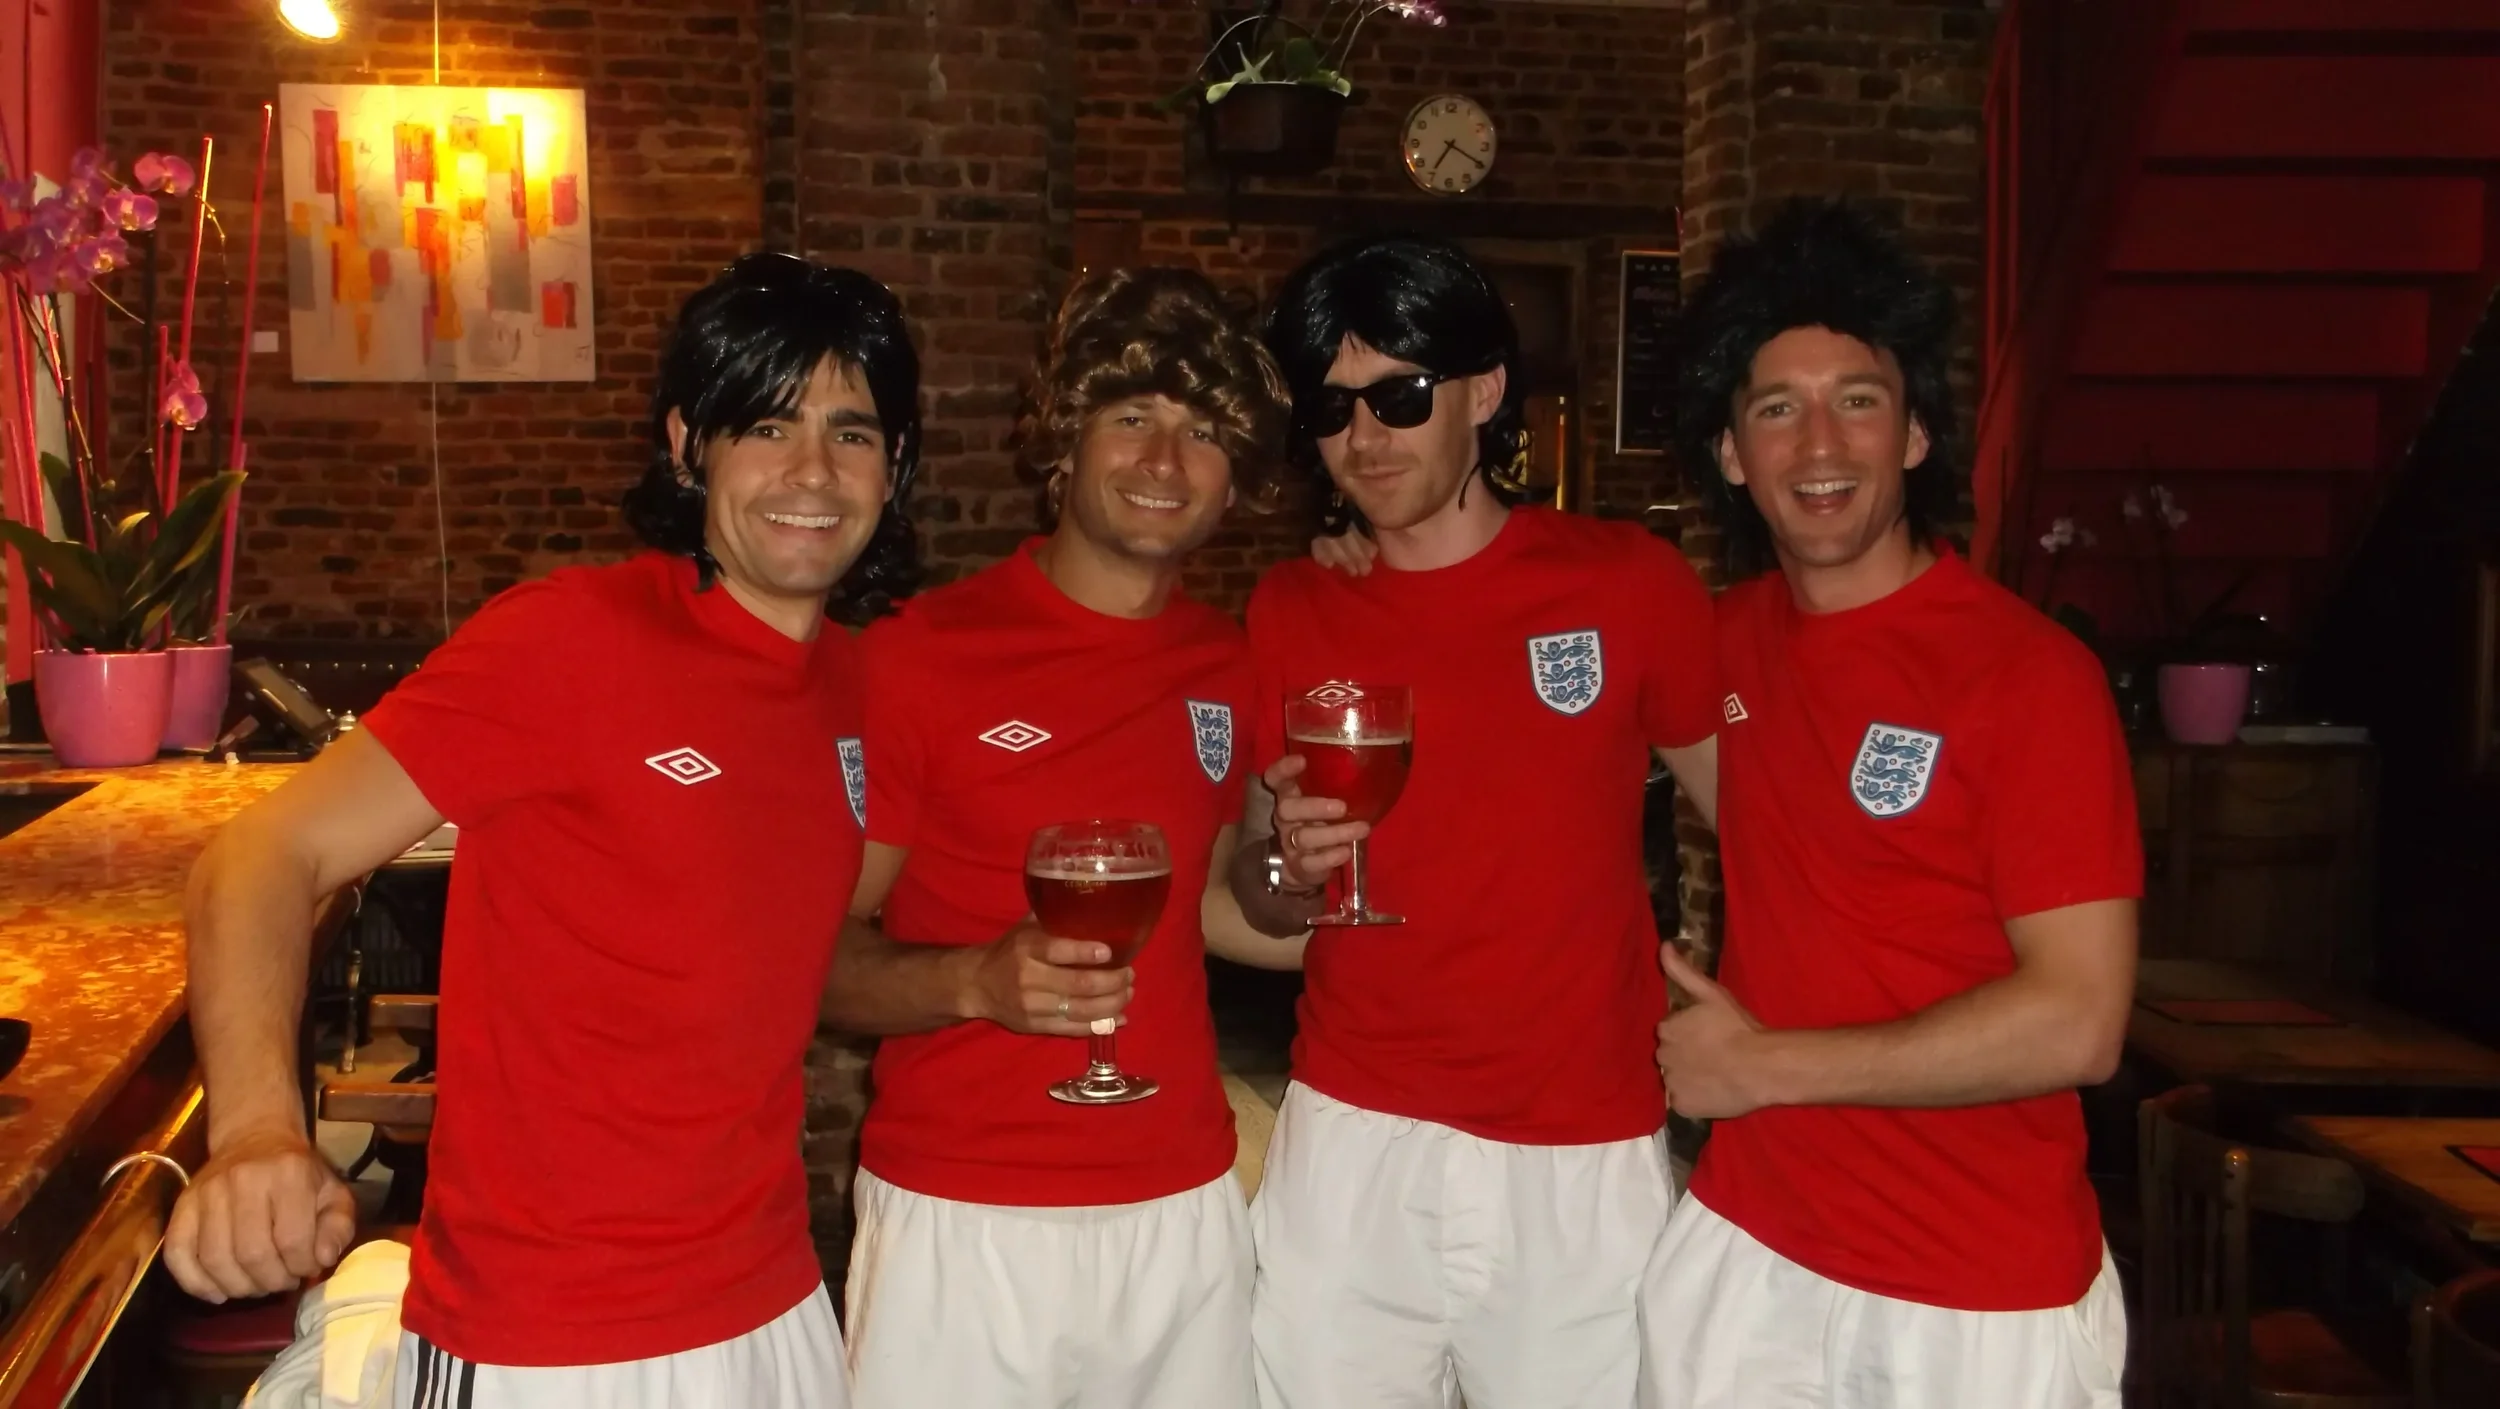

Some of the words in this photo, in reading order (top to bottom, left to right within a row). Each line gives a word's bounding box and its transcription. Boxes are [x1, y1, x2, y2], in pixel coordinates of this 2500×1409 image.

[1445, 103, 1457, 113] 12
[1411, 138, 1420, 148] 9
[1480, 142, 1489, 152] 3
[1428, 172, 1436, 182] 7
[1462, 173, 1471, 184] 5
[1444, 177, 1453, 188] 6
